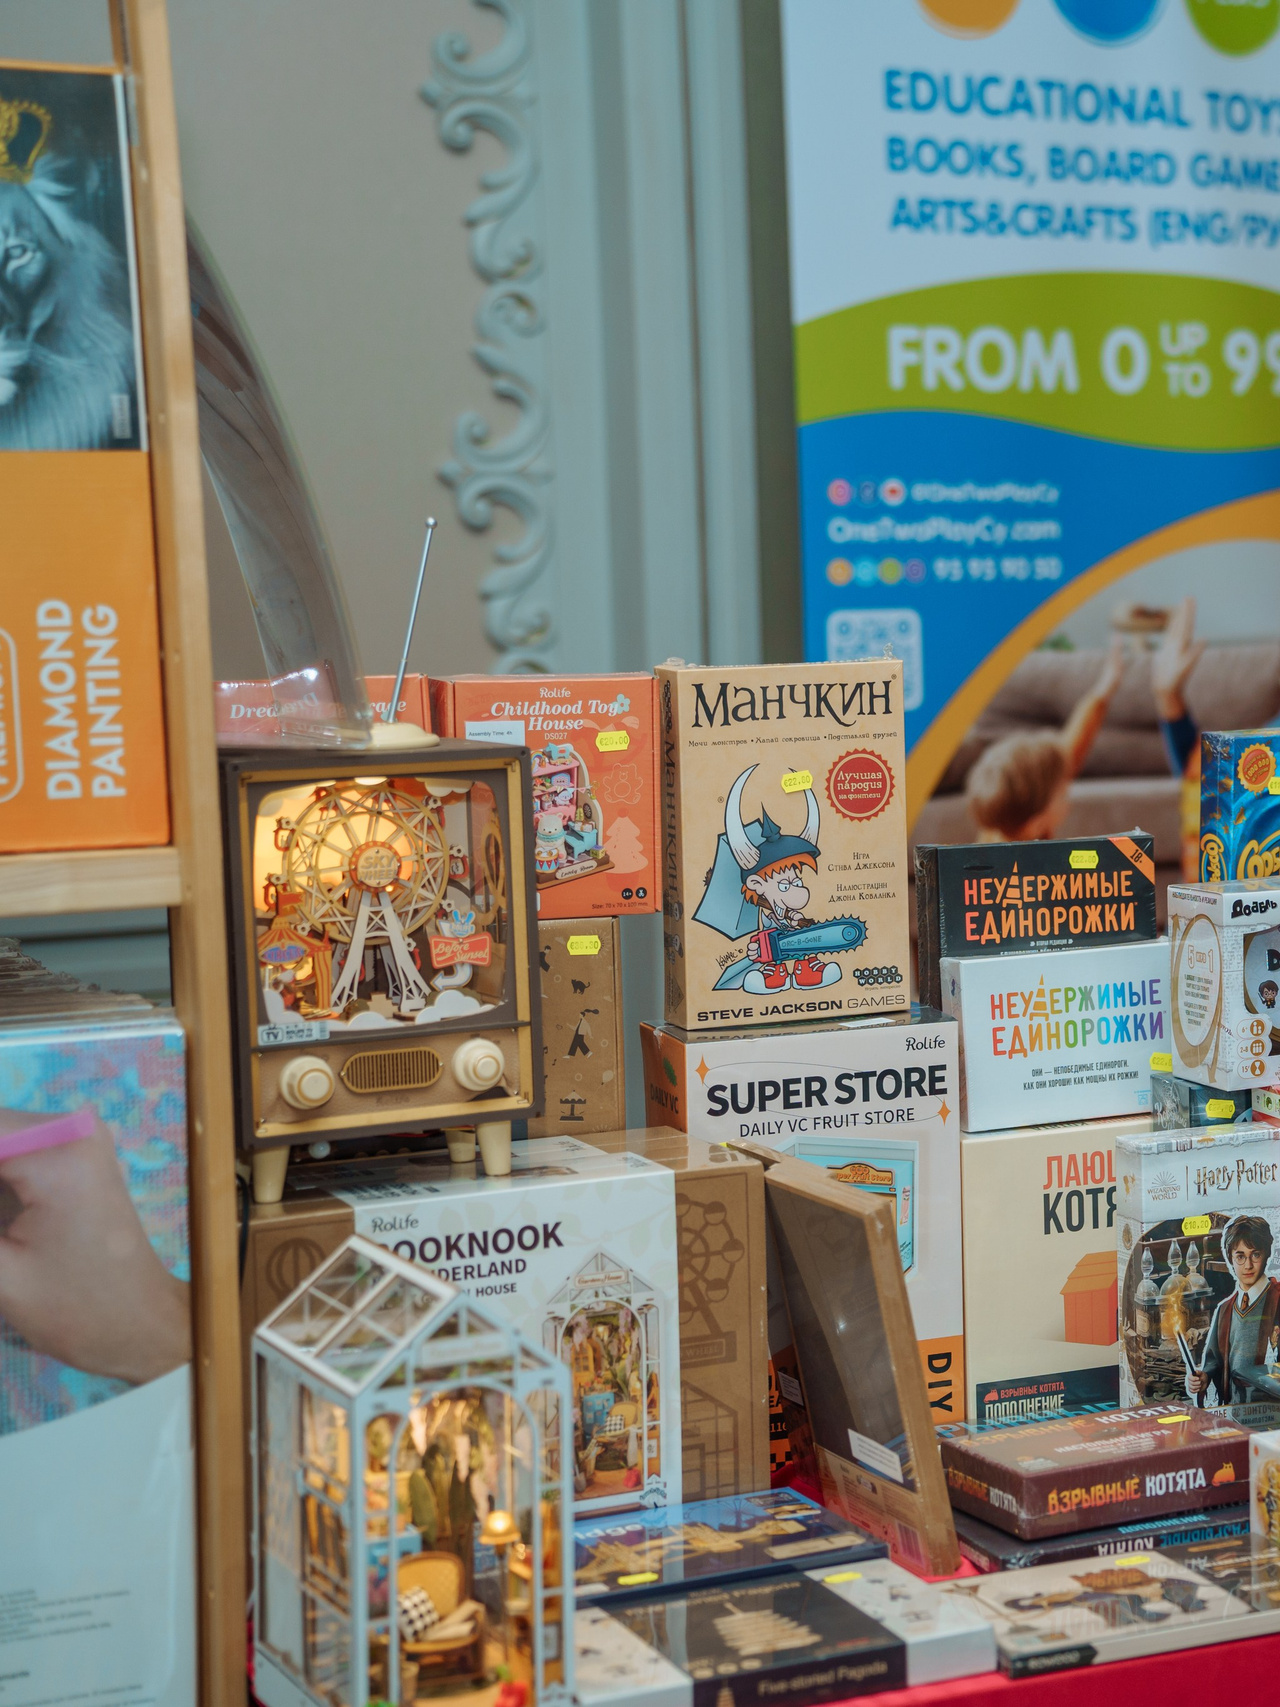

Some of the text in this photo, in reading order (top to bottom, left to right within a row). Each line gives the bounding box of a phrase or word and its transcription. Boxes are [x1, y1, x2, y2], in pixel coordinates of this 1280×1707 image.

[884, 68, 1190, 129] EDUCATIONAL
[886, 136, 1038, 186] BOOKS,
[1047, 146, 1177, 187] BOARD
[889, 195, 1139, 243] ARTS&CRAFTS
[1160, 322, 1208, 357] UP
[887, 324, 1148, 396] FROM 0
[1164, 363, 1211, 398] TO
[36, 598, 82, 799] DIAMOND
[82, 604, 127, 798] PAINTING
[490, 700, 619, 717] Childhood Toy
[539, 687, 571, 698] Rolife
[691, 680, 892, 728] Манчкин
[528, 717, 584, 731] House
[688, 731, 898, 747] Мочи Хапай сокровища Подставляй друзей
[358, 869, 397, 880] WHEEL
[361, 855, 395, 869] SKY
[964, 861, 1133, 908] НЕУДЕРЖИМЫЕ
[965, 902, 1135, 945] ЕДИНОРОЖКИ
[854, 966, 898, 978] HOBBY
[858, 974, 902, 986] WORLD
[697, 994, 905, 1021] STEVE JACKSON GAMES
[990, 973, 1162, 1022] НЕУДЕРЖИМЫЕ
[906, 1037, 946, 1051] Rolife
[992, 1011, 1164, 1060] ЕДИНОРОЖКИ
[1023, 1071, 1139, 1091] КАК ОНИ КАК МОЩНЫ РОЖКИ!
[1031, 1062, 1094, 1077] ОНИ НЕПОБЕДИМЫЕ
[706, 1064, 948, 1118] SUPER STORE
[739, 1107, 915, 1139] DAILY VC FRUIT STORE
[1194, 1158, 1278, 1197] Harry Potter
[1043, 1186, 1116, 1235] КОТЯ
[1151, 1192, 1178, 1201] WORLD
[372, 1214, 419, 1233] Rolife
[378, 1221, 564, 1264] OOKNOOK
[475, 1282, 518, 1298] HOUSE
[927, 1352, 953, 1413] DIY
[1000, 1381, 1065, 1398] ВЗРЫВНЫЕ КОТЯТА
[1047, 1468, 1207, 1515] ВЗРЫВНЫЕ КОТЯТА
